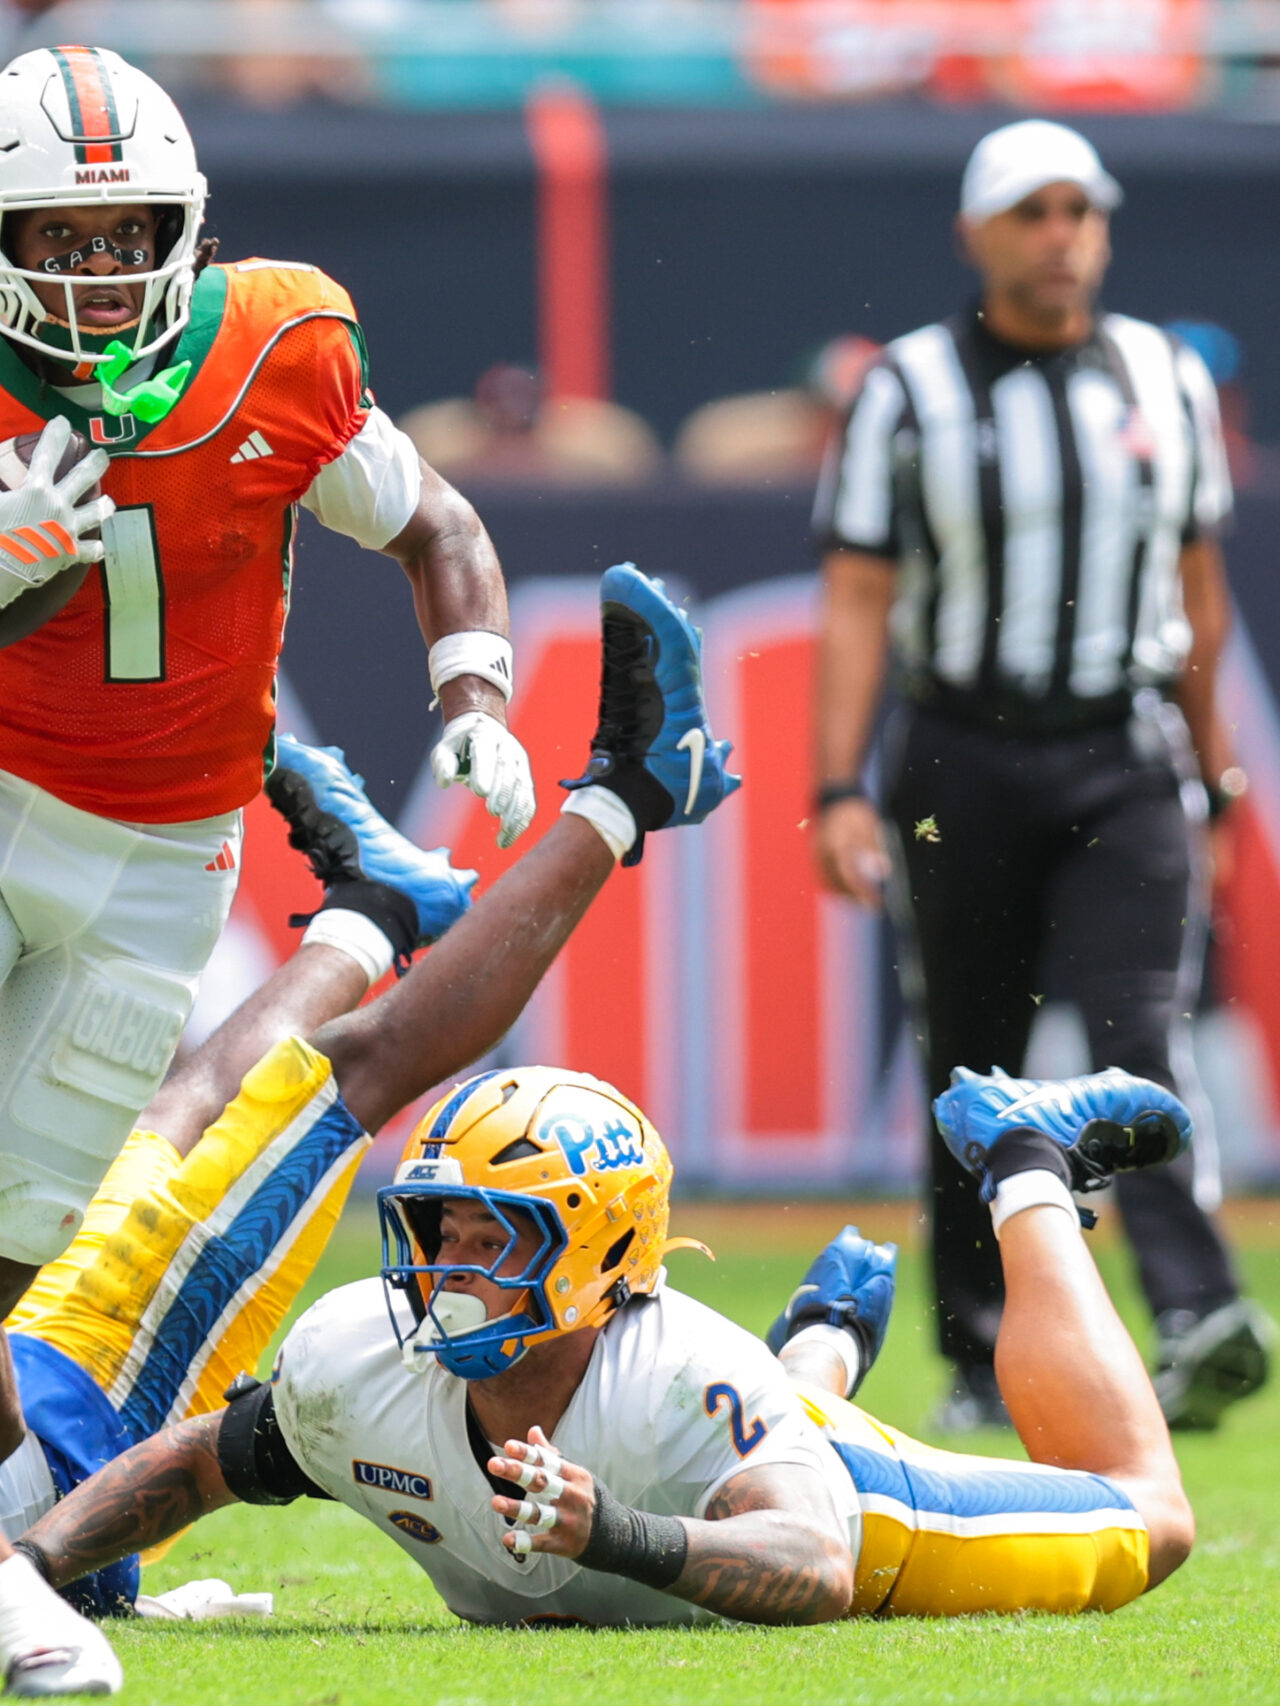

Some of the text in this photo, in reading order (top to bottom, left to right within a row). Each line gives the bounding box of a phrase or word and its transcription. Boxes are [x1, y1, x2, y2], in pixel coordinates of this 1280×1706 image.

[75, 168, 131, 184] MIAMI
[97, 502, 166, 684] 1
[538, 1112, 645, 1175] Pitt
[702, 1380, 769, 1460] 2
[359, 1463, 428, 1498] UPMC
